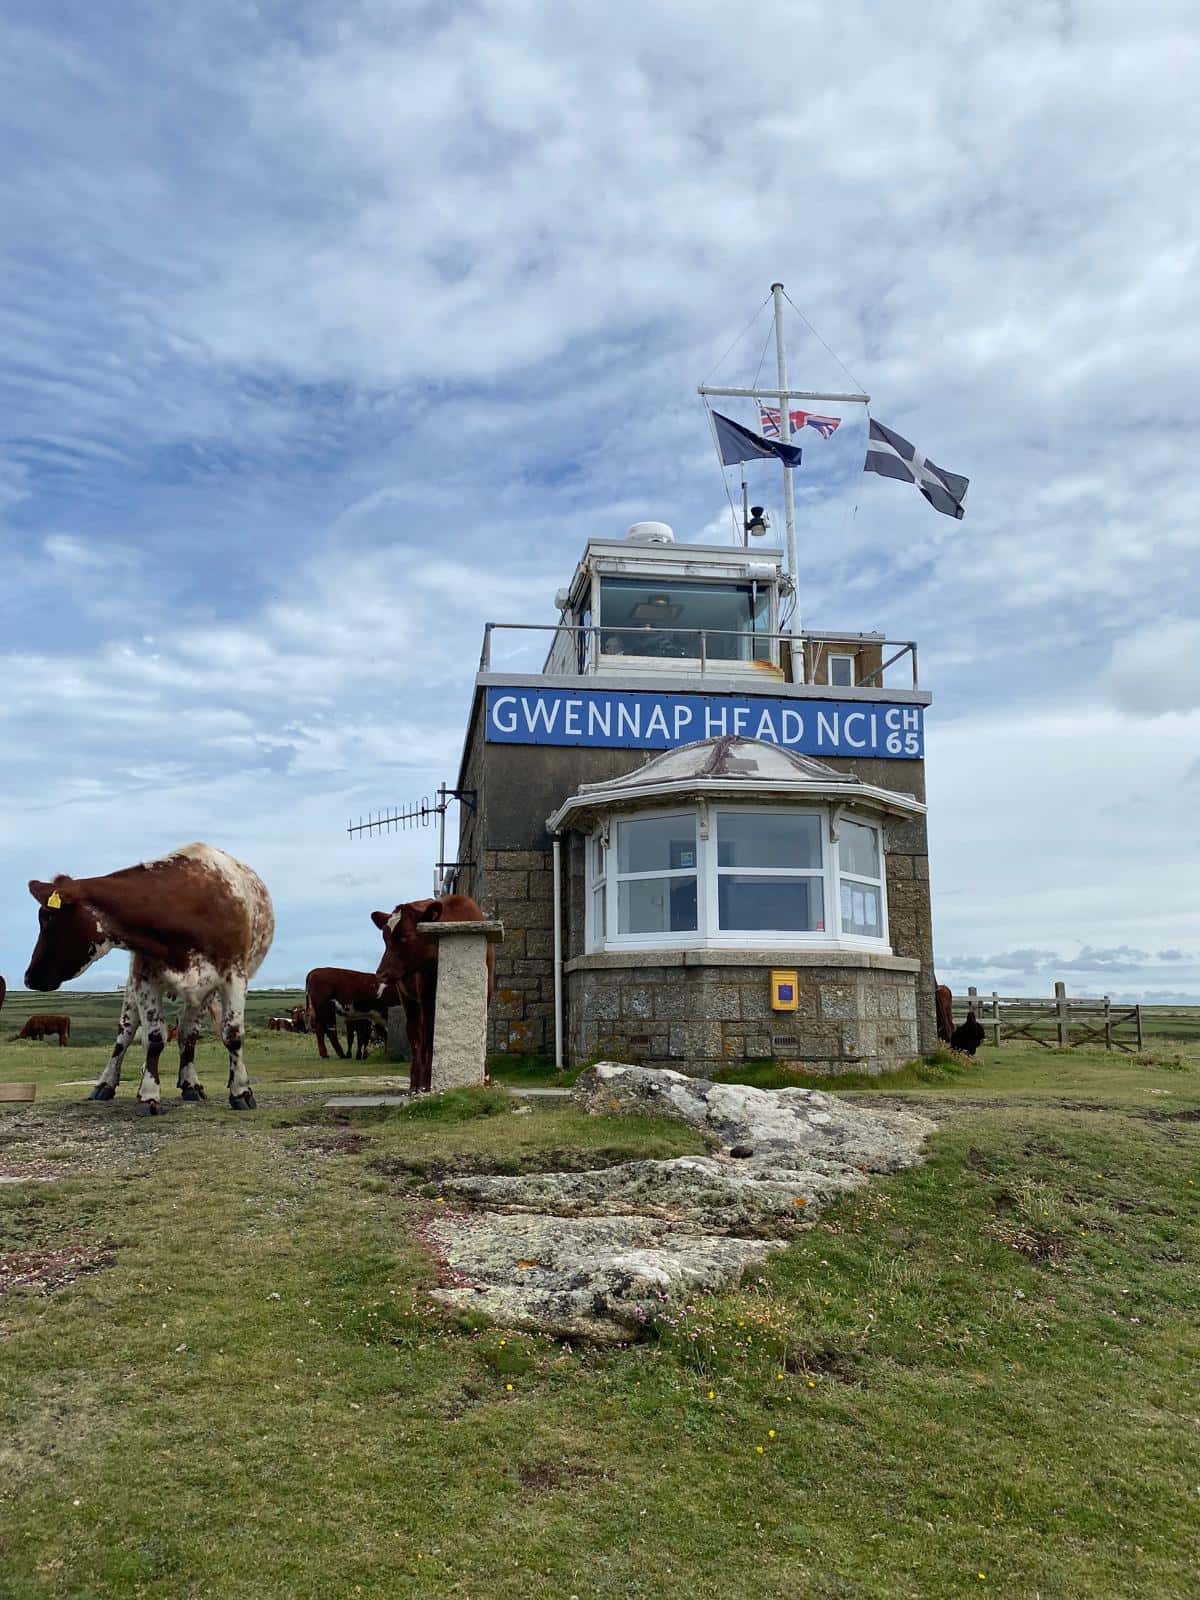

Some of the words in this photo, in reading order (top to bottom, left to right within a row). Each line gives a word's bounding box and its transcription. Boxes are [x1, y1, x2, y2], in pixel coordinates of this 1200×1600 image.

[492, 696, 693, 740] GWENNAP
[704, 706, 804, 745] HEAD
[818, 711, 877, 749] NCI
[886, 708, 919, 731] CH
[886, 731, 919, 755] 65
